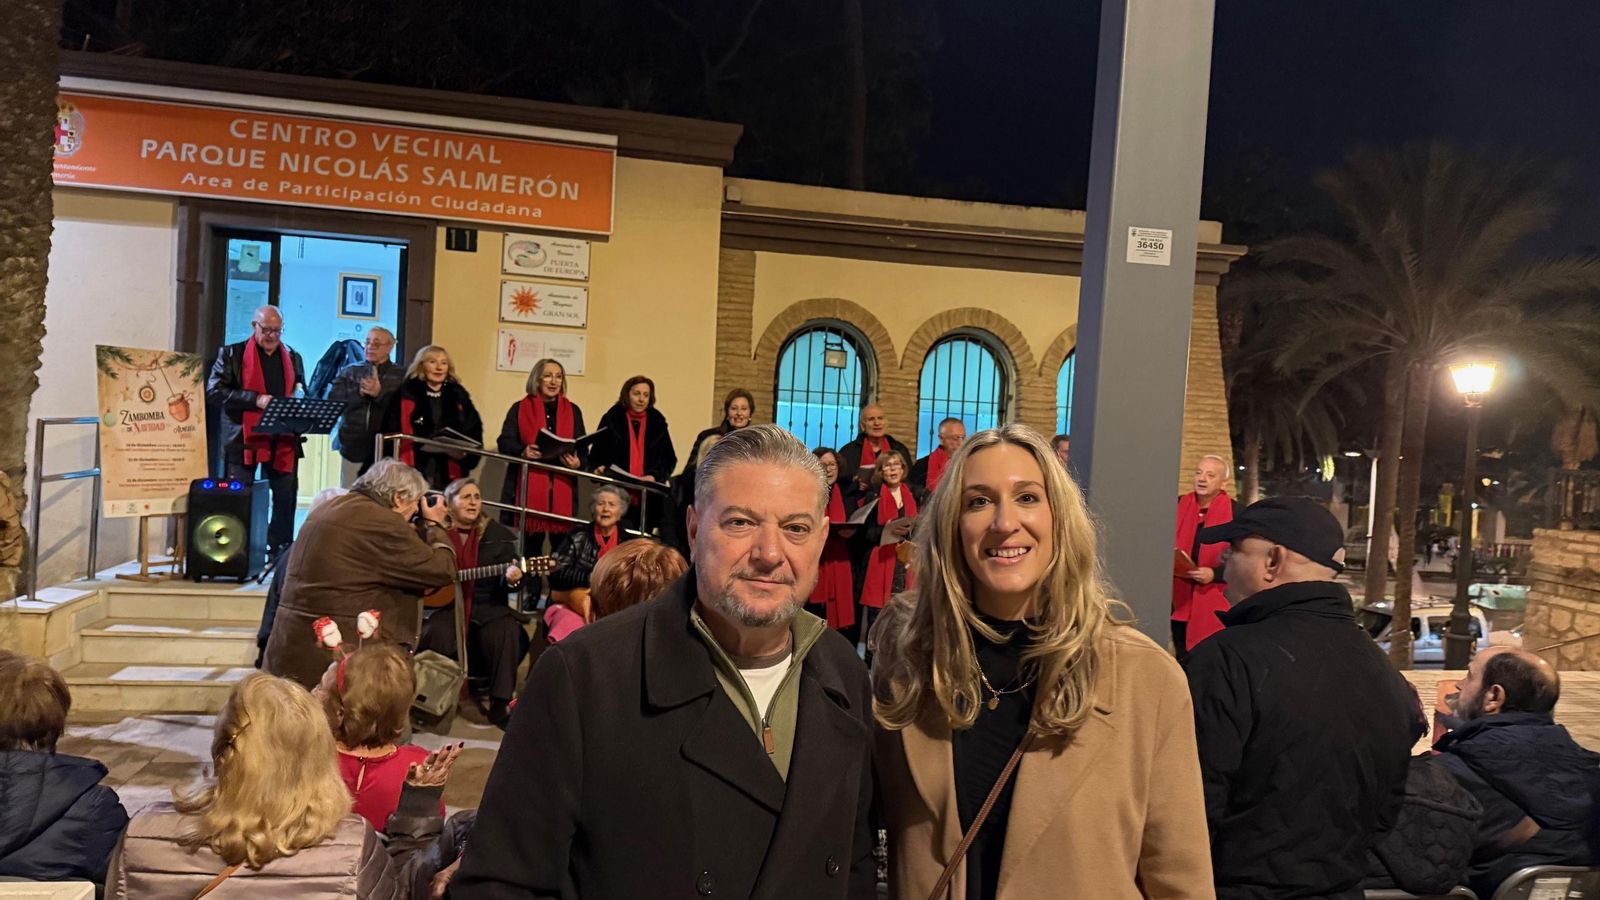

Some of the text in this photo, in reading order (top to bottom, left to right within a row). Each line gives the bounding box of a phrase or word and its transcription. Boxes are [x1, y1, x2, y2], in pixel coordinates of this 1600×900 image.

[229, 118, 502, 165] CENTRO VECINAL
[140, 139, 580, 201] PARQUE NICOLÁS SALMERÓN
[181, 172, 543, 218] Area de Participación Ciudadana
[450, 229, 470, 250] 11
[1136, 240, 1164, 250] 36450
[550, 259, 579, 268] PUERTA
[555, 267, 585, 275] EUROPA
[542, 310, 580, 319] GRAN SOL
[119, 409, 165, 426] ZAMBOMBA
